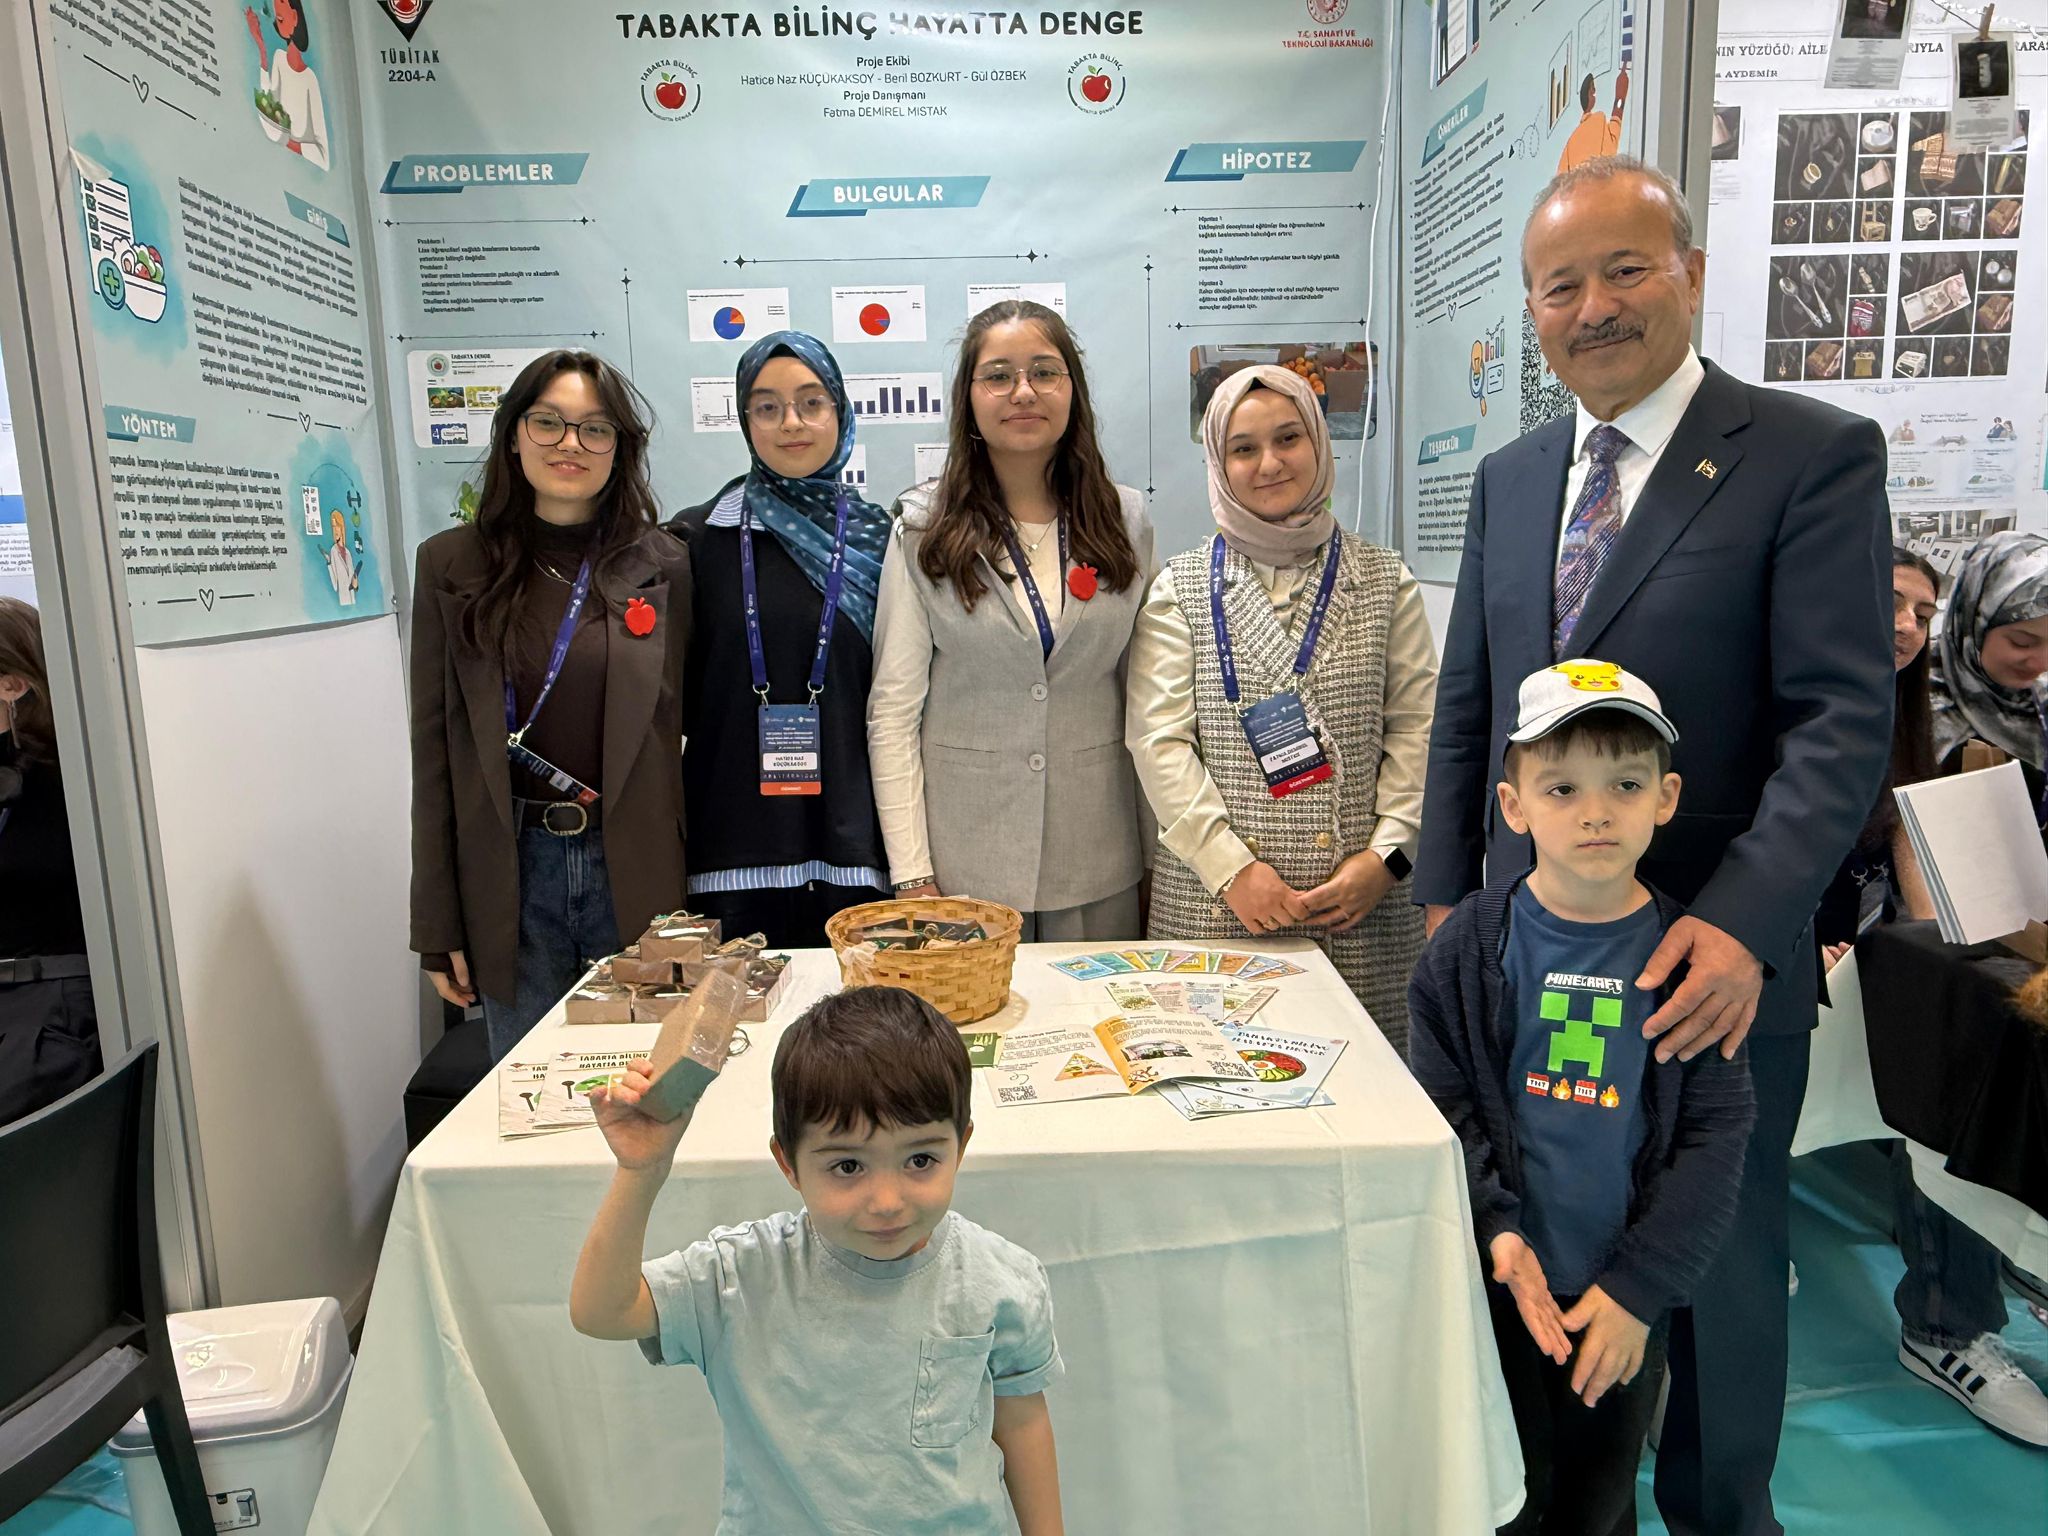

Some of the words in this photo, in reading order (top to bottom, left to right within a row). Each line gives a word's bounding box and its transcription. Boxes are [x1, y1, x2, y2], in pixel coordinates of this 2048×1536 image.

[616, 14, 762, 38] TABAKTA
[774, 5, 877, 40] BİLİNÇ
[889, 12, 1028, 35] HAYATTA
[1040, 10, 1143, 35] DENGE
[1345, 29, 1356, 37] VE
[380, 47, 440, 64] TÜBİTAK
[856, 56, 883, 69] Proje
[886, 55, 911, 66] Ekibi
[389, 69, 436, 82] 2204-A
[741, 75, 774, 85] Hatice
[777, 74, 797, 84] Naz
[799, 72, 874, 86] KÜÇÜKAKSOY
[884, 73, 908, 83] Beril
[910, 72, 961, 83] BOZKURT
[971, 71, 988, 82] Gül
[990, 69, 1027, 81] ÖZBEK
[844, 91, 870, 102] Proje
[872, 91, 926, 102] Danışmanı
[823, 107, 856, 117] Fatma
[858, 105, 904, 117] DEMİREL
[907, 106, 948, 117] MISTAK
[1222, 147, 1312, 169] HİPOTEZ
[413, 163, 554, 182] PROBLEMLER
[833, 184, 943, 203] BULGULAR
[121, 412, 177, 438] YÖNTEM
[132, 510, 137, 520] 3
[1545, 972, 1623, 994] MINECRAFT
